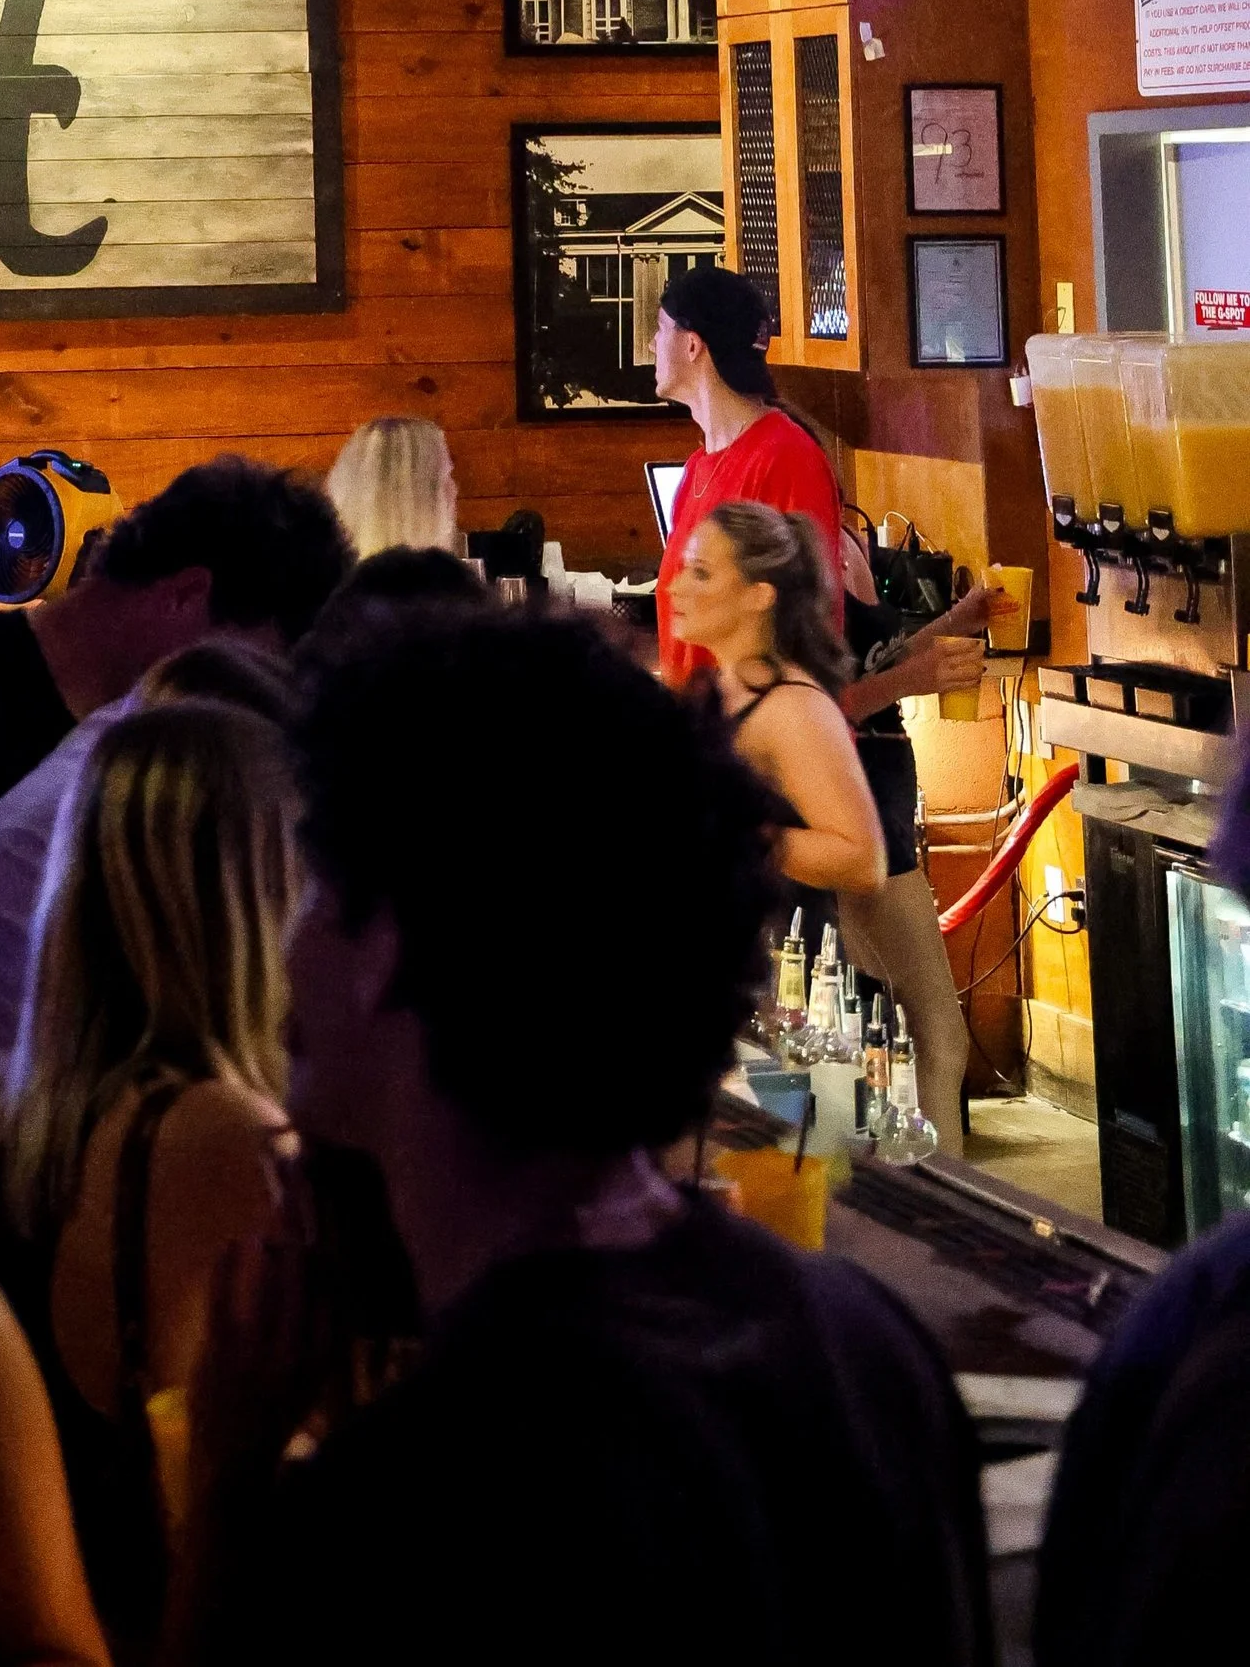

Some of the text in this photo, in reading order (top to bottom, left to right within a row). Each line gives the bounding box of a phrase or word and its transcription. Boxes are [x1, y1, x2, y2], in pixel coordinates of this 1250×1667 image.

[1179, 5, 1199, 15] CREDIT
[1218, 3, 1226, 12] WE
[1191, 25, 1197, 34] TO
[1199, 24, 1212, 33] HELP
[1213, 22, 1235, 32] OFFSET
[1176, 44, 1199, 54] AMOUNT
[1207, 43, 1219, 52] NOT
[1220, 42, 1235, 51] MORE
[1195, 63, 1207, 73] NOT
[1207, 62, 1241, 72] SURCHARGE
[1195, 291, 1250, 307] FOLLOW ME TO
[1201, 305, 1245, 321] THE G-SPOT
